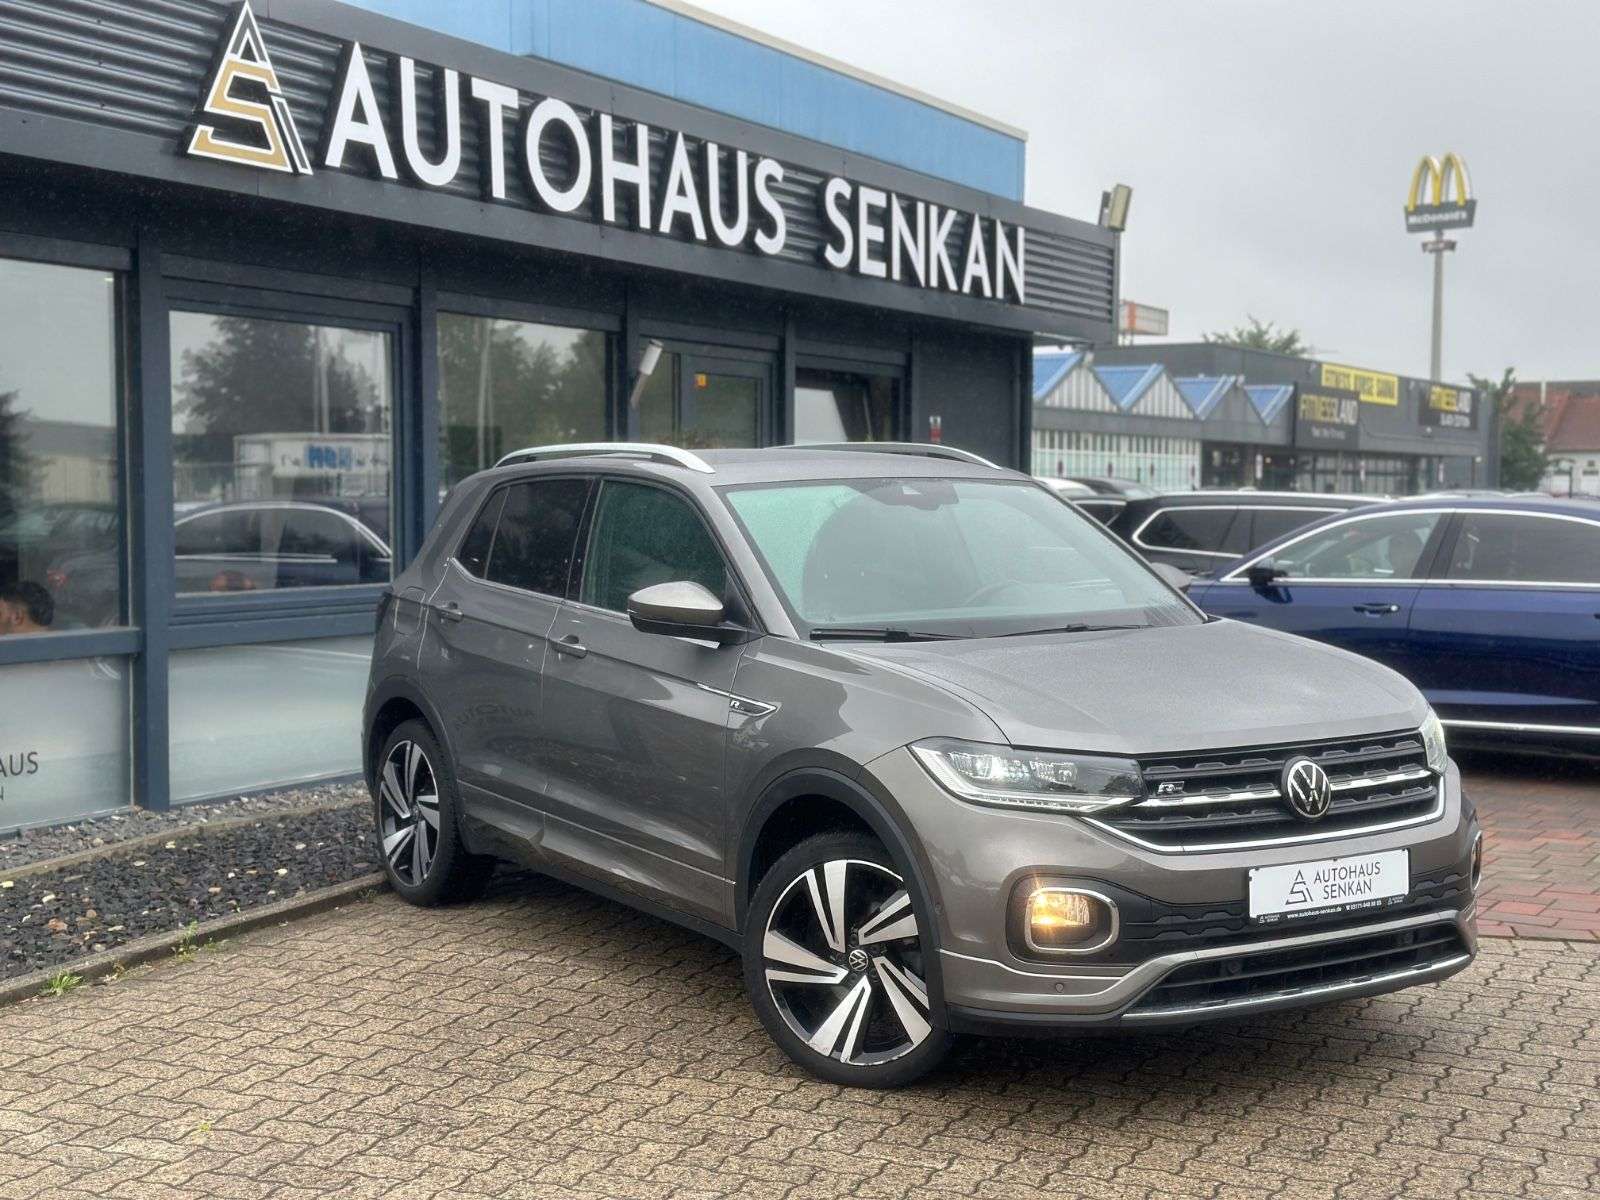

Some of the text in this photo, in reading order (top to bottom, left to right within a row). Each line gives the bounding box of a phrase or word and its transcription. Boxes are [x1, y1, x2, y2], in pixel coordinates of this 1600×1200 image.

[324, 40, 1026, 304] AUTOHAUS SENKAN
[1313, 861, 1381, 885] AUTOHAUS
[1322, 878, 1372, 900] SENKAN
